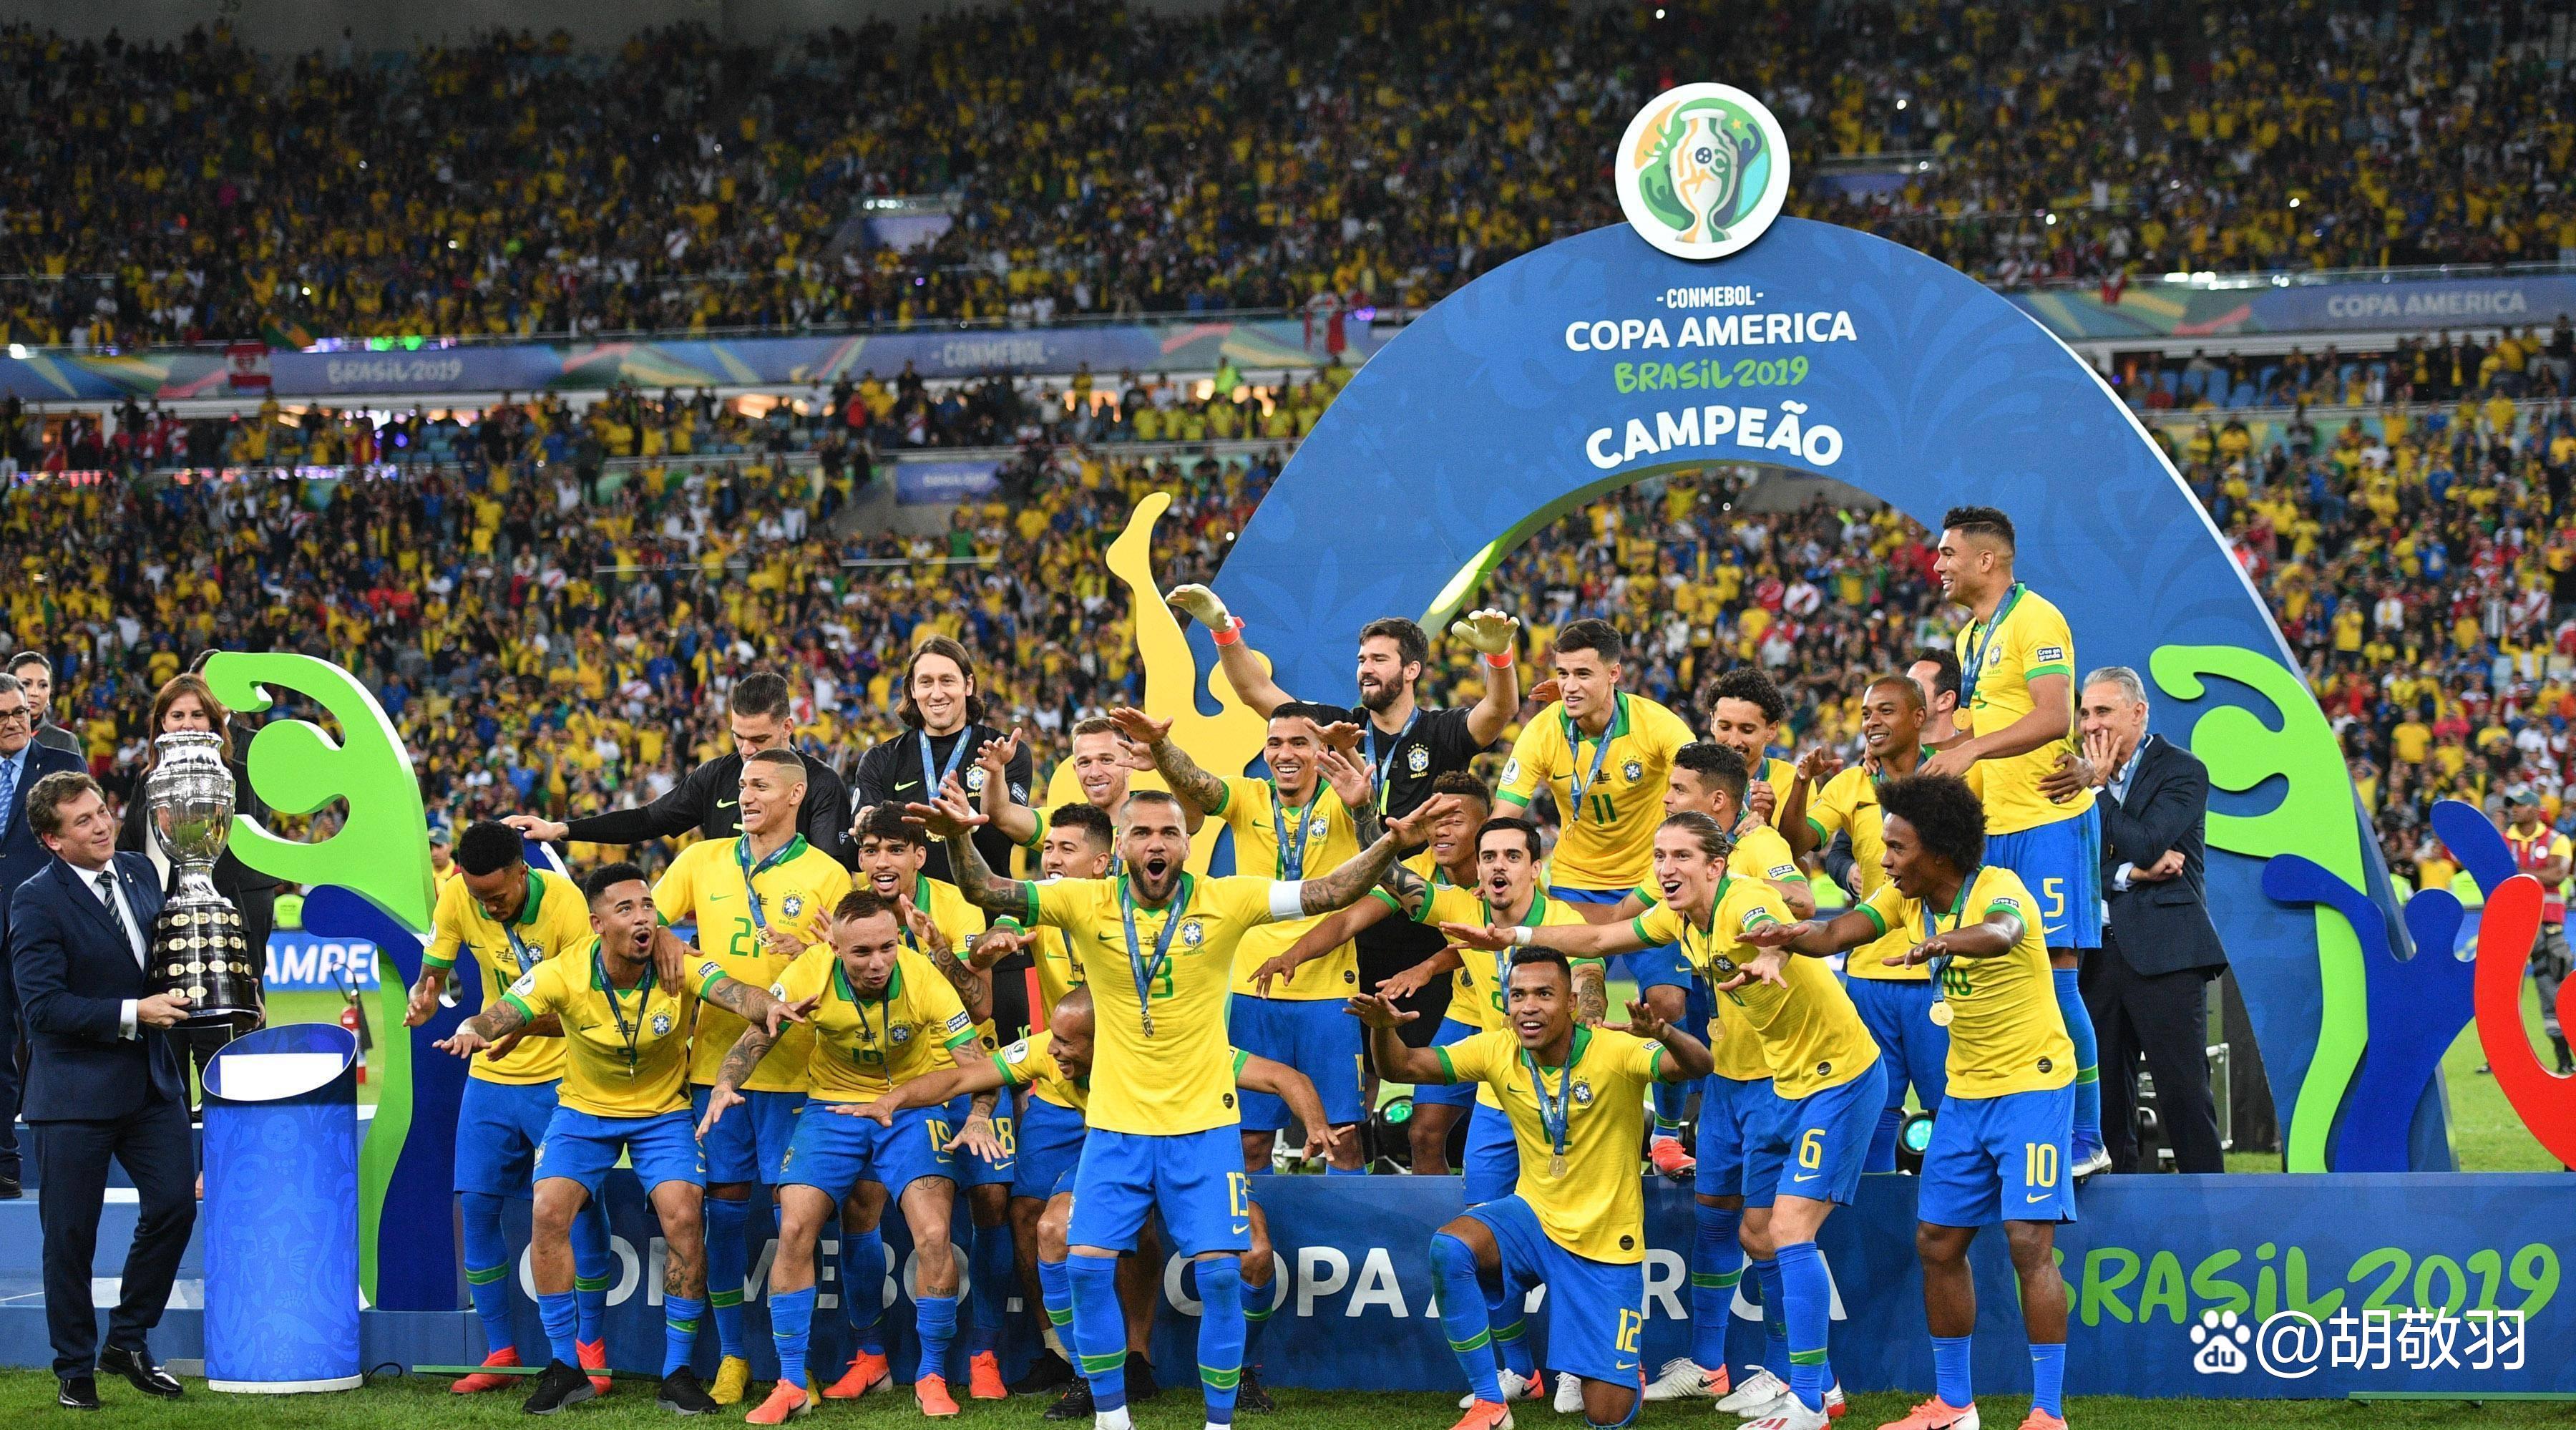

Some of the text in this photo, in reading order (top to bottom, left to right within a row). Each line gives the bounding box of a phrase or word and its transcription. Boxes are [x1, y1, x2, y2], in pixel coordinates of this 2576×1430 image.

[2328, 289, 2527, 318] COPA AMERICA
[1565, 311, 1858, 351] COPA AMERICA
[409, 358, 463, 381] 2019
[1732, 356, 1809, 387] 2019
[1585, 399, 1843, 470] CAMPEÃO
[1590, 794, 1617, 825] 11
[2043, 877, 2064, 917] 5
[1141, 956, 1174, 998] 3
[1942, 967, 1973, 996] 10
[925, 1119, 954, 1155] 19
[1799, 1128, 1825, 1169] 6
[2026, 1142, 2057, 1187] 10
[1226, 1172, 1249, 1217] 13
[2346, 1242, 2560, 1325] 2019
[1615, 1308, 1642, 1353] 12
